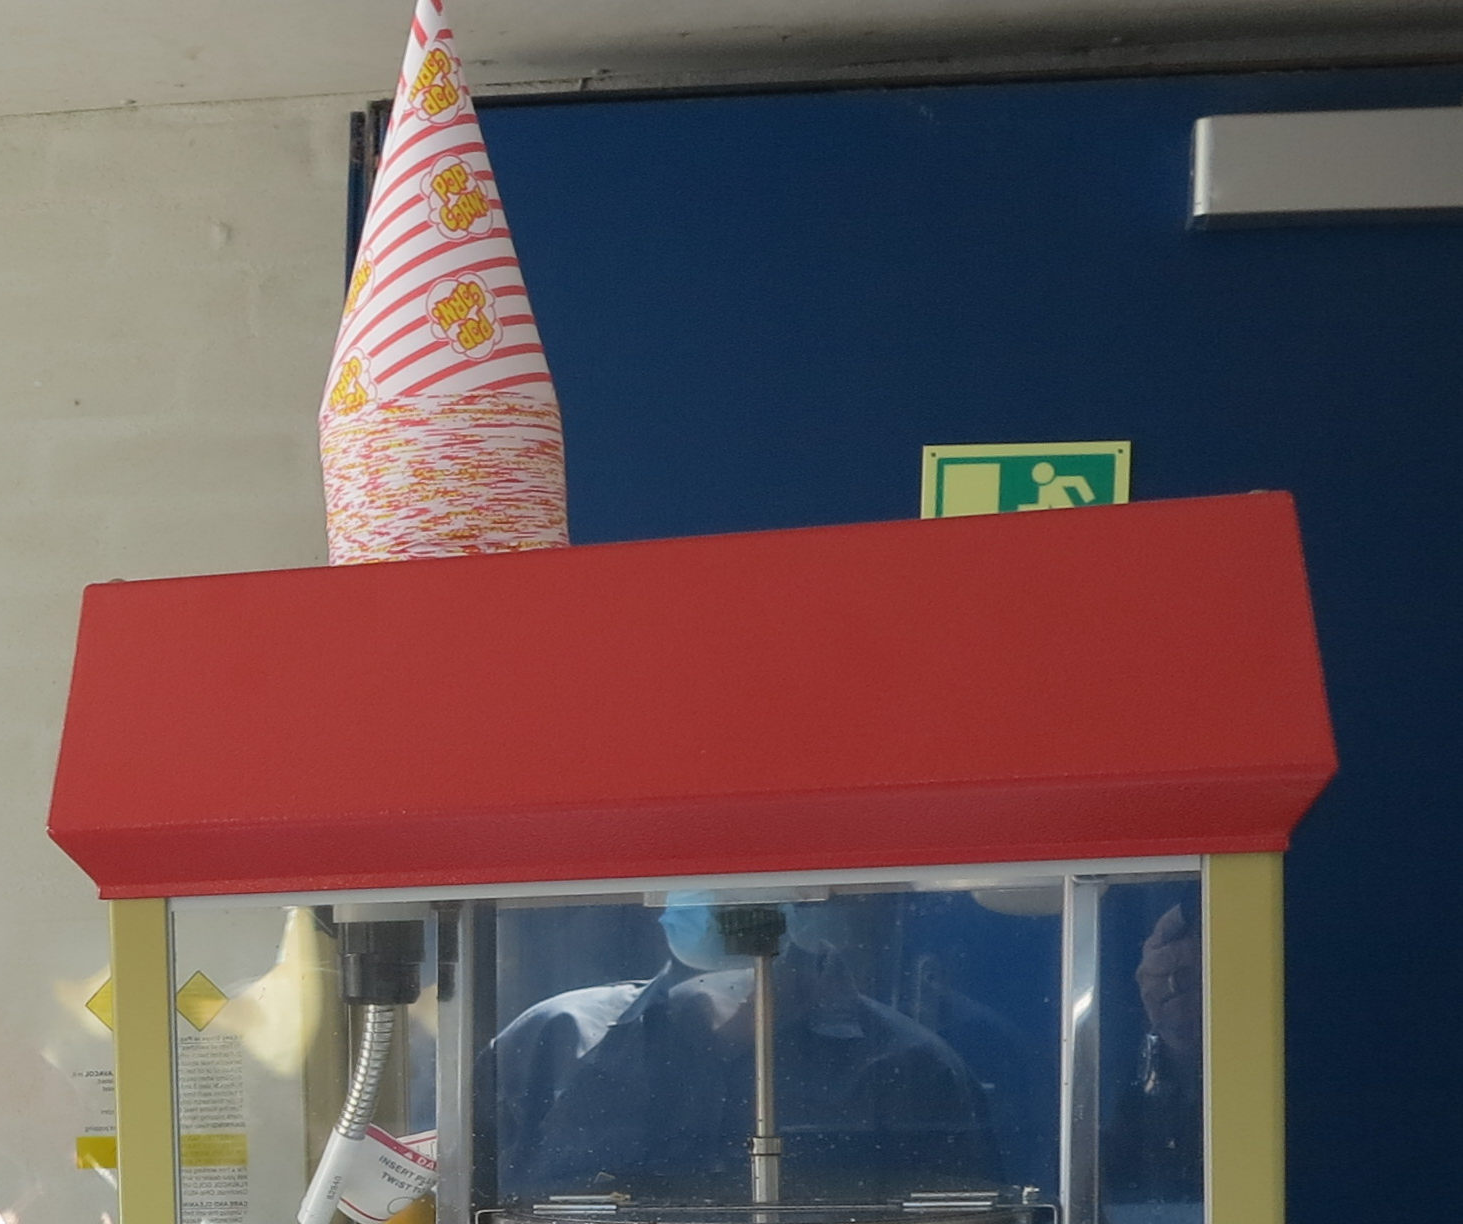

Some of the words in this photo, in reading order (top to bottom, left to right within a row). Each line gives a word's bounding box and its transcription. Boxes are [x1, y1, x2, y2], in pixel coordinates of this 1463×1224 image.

[430, 162, 470, 204] POP
[440, 185, 490, 232] CORN!
[456, 308, 495, 351] POP
[379, 1154, 415, 1178] INSERT
[381, 1171, 413, 1191] TWIST
